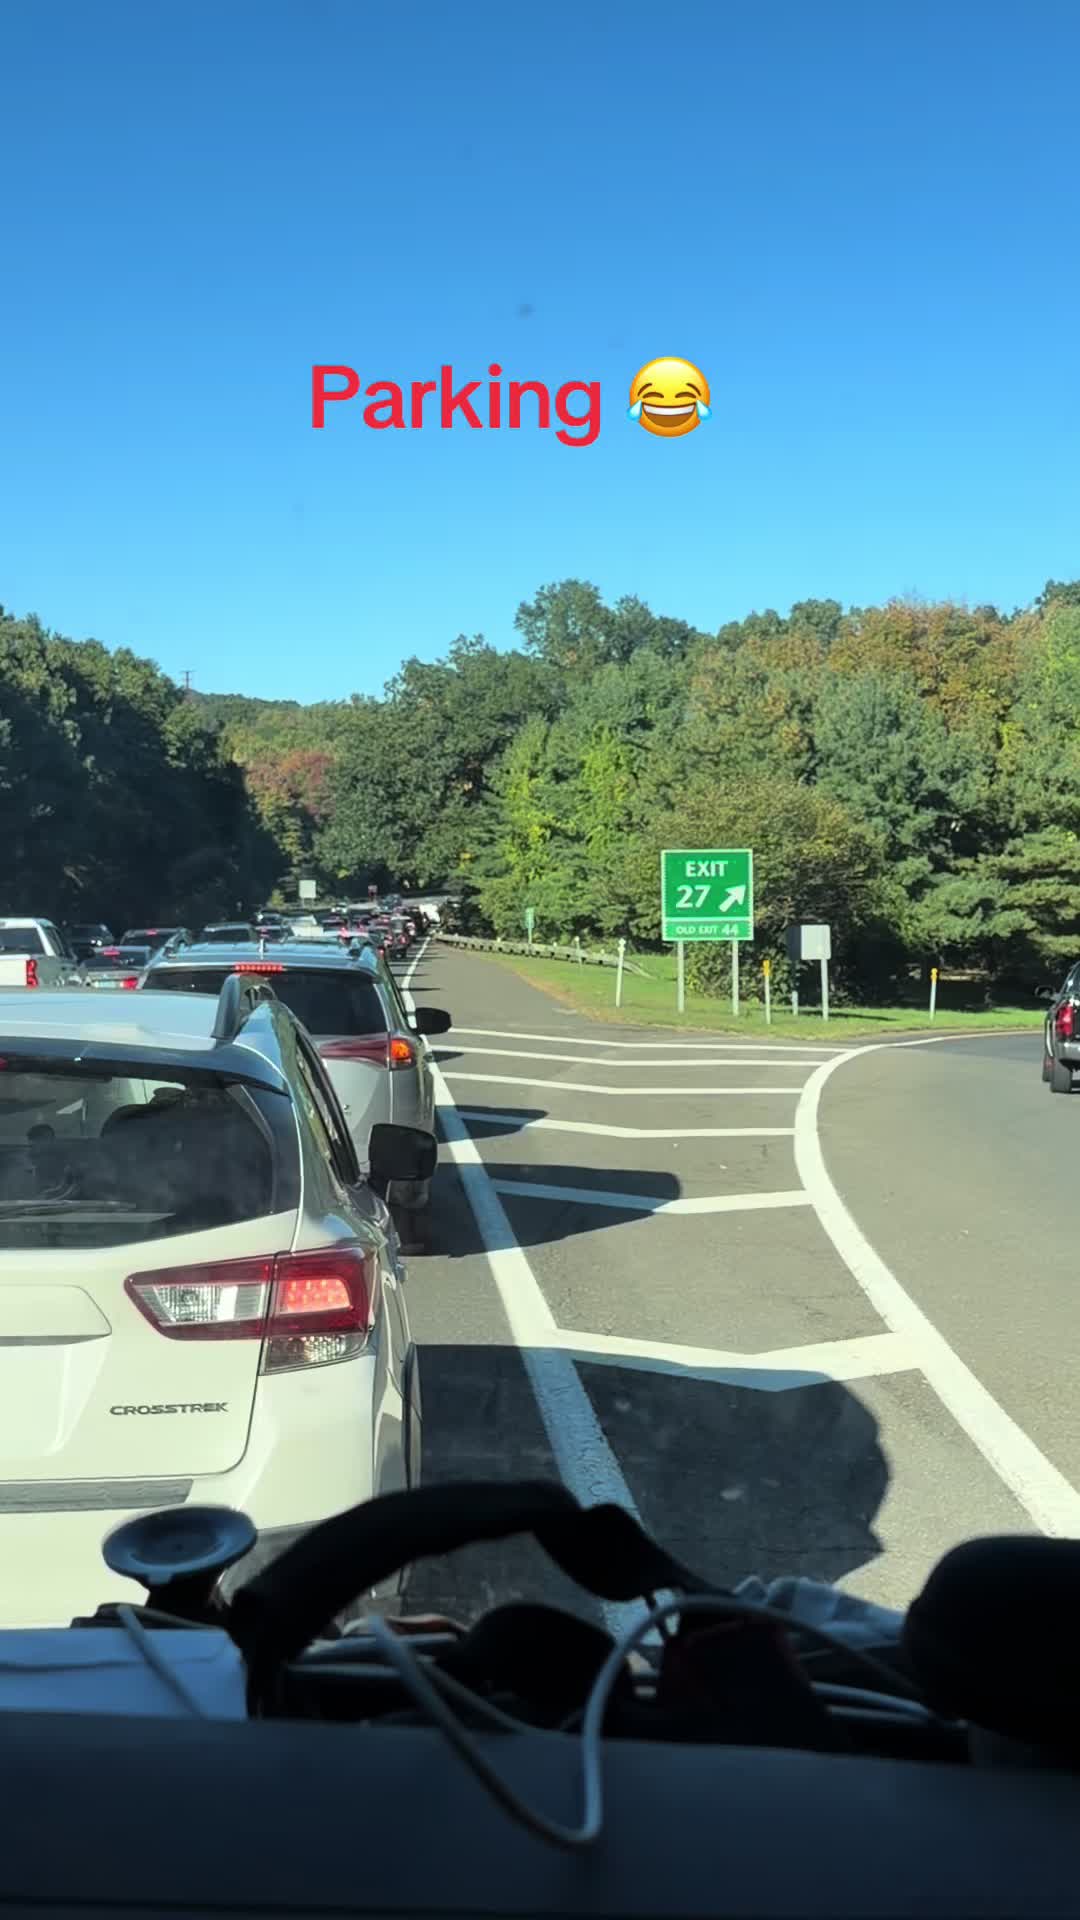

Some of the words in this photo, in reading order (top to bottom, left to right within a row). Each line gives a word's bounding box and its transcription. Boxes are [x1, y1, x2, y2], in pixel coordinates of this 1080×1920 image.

[685, 860, 729, 877] EXIT
[676, 884, 711, 908] 27
[675, 925, 696, 935] OLD
[698, 925, 718, 935] EXIT
[721, 924, 739, 936] 44
[109, 1402, 229, 1416] CROSSTREK
